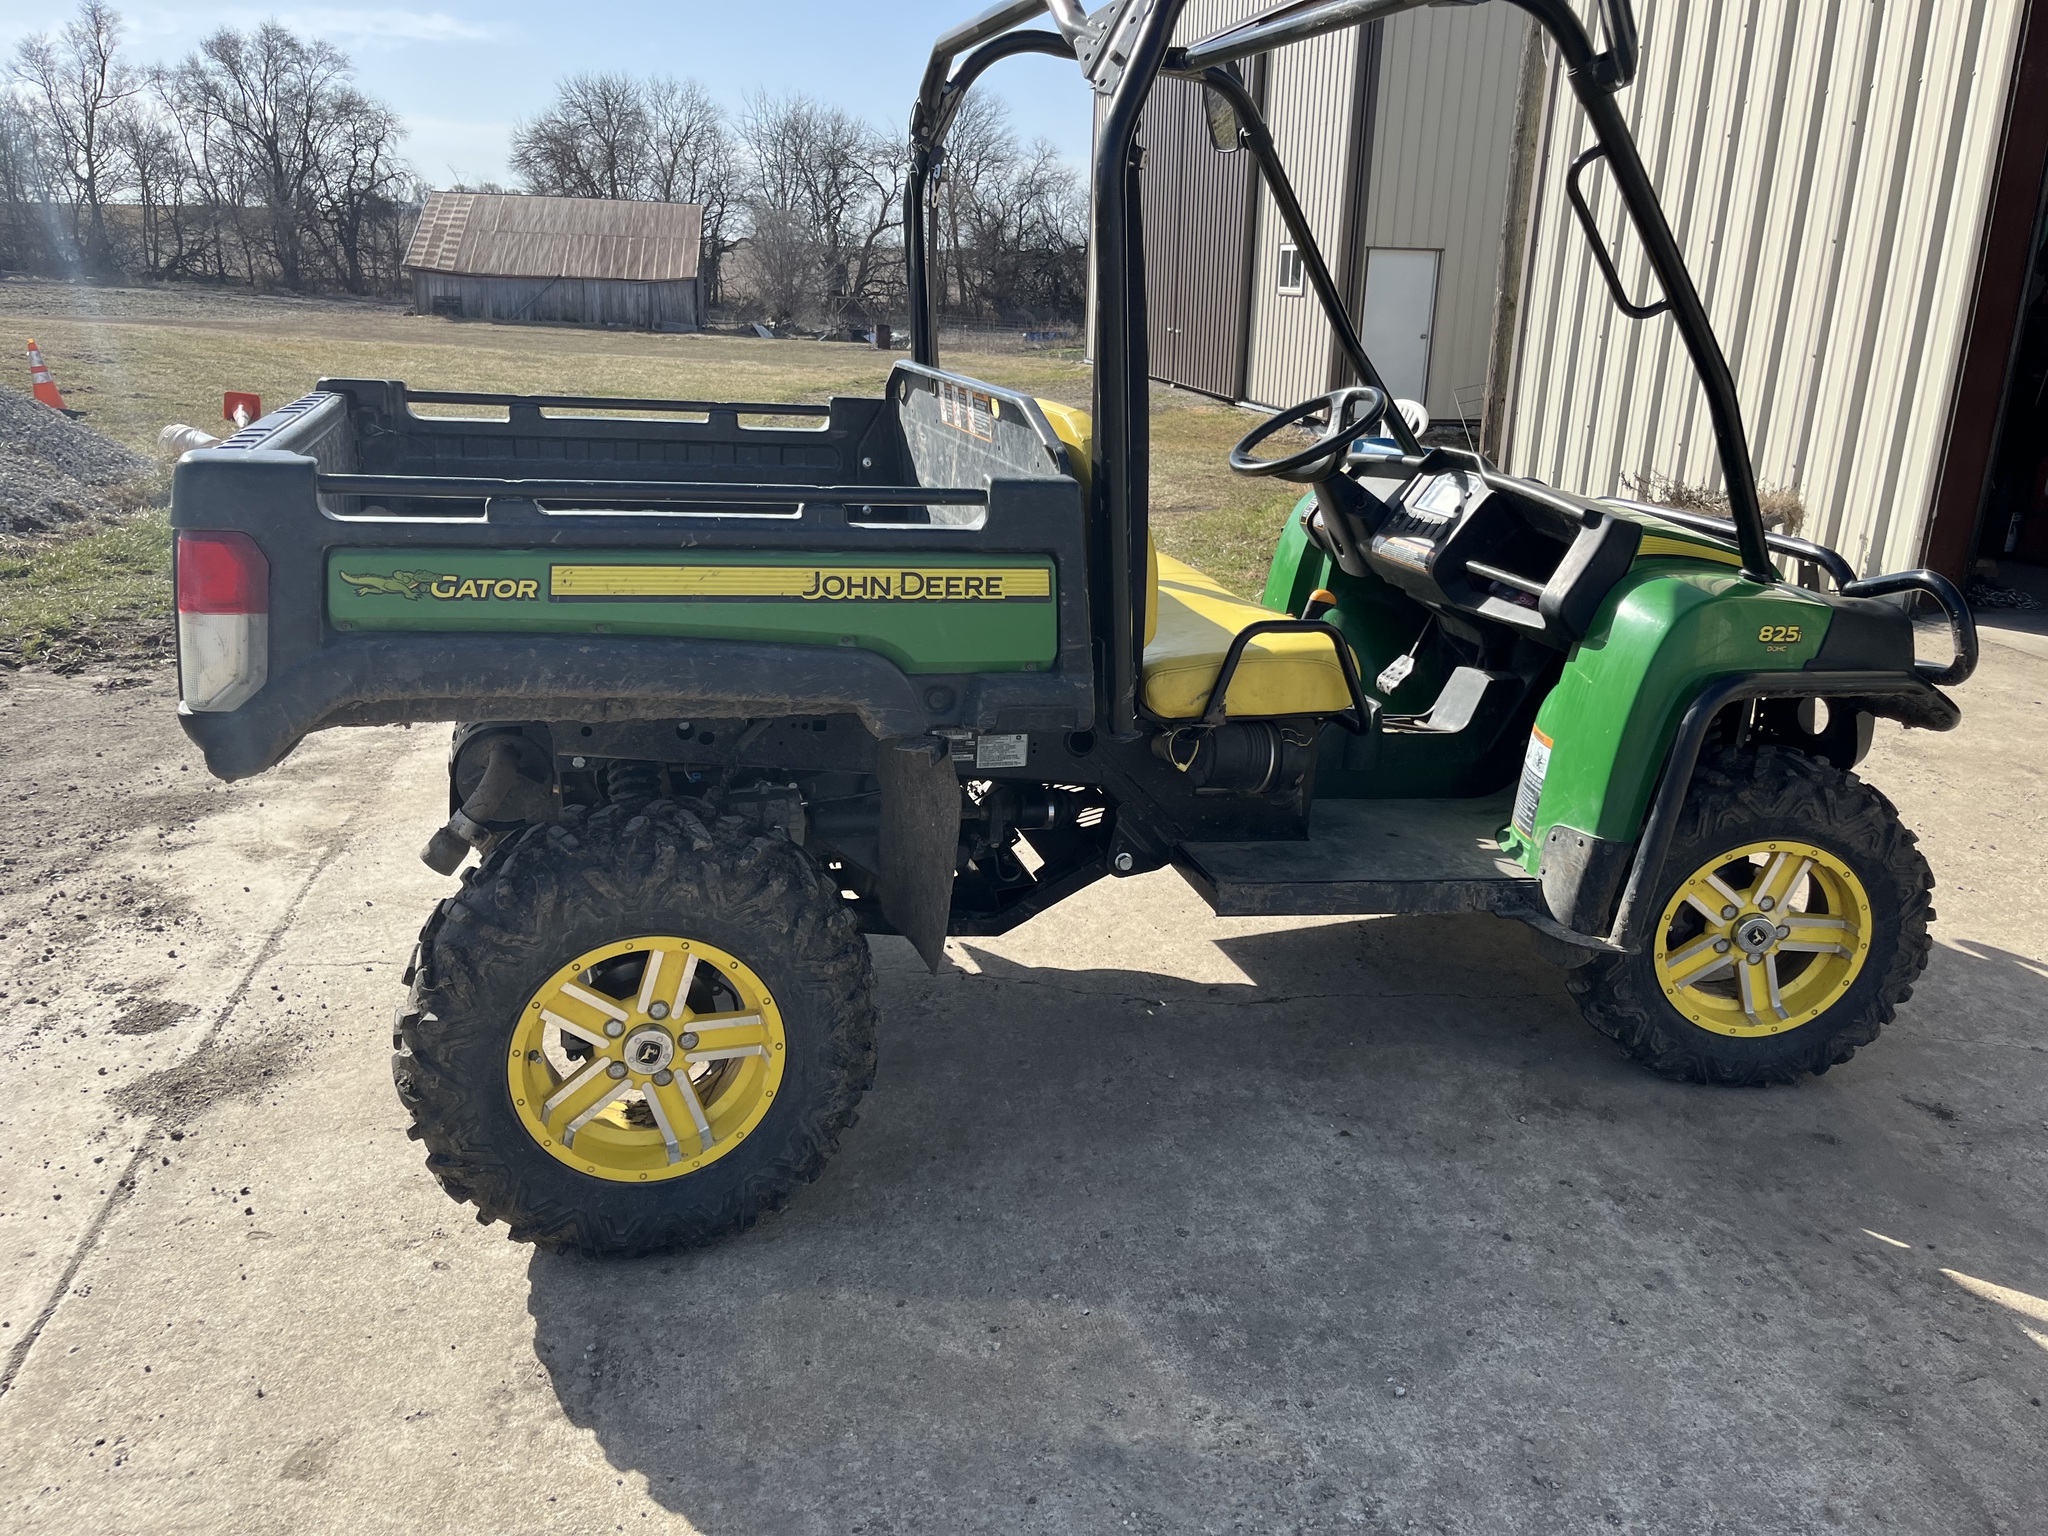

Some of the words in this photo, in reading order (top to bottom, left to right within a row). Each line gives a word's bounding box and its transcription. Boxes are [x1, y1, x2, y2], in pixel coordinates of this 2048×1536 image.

[430, 575, 539, 600] GATOR
[802, 571, 893, 598] JOHN
[900, 571, 1005, 598] DEERE
[1758, 625, 1802, 642] 825i
